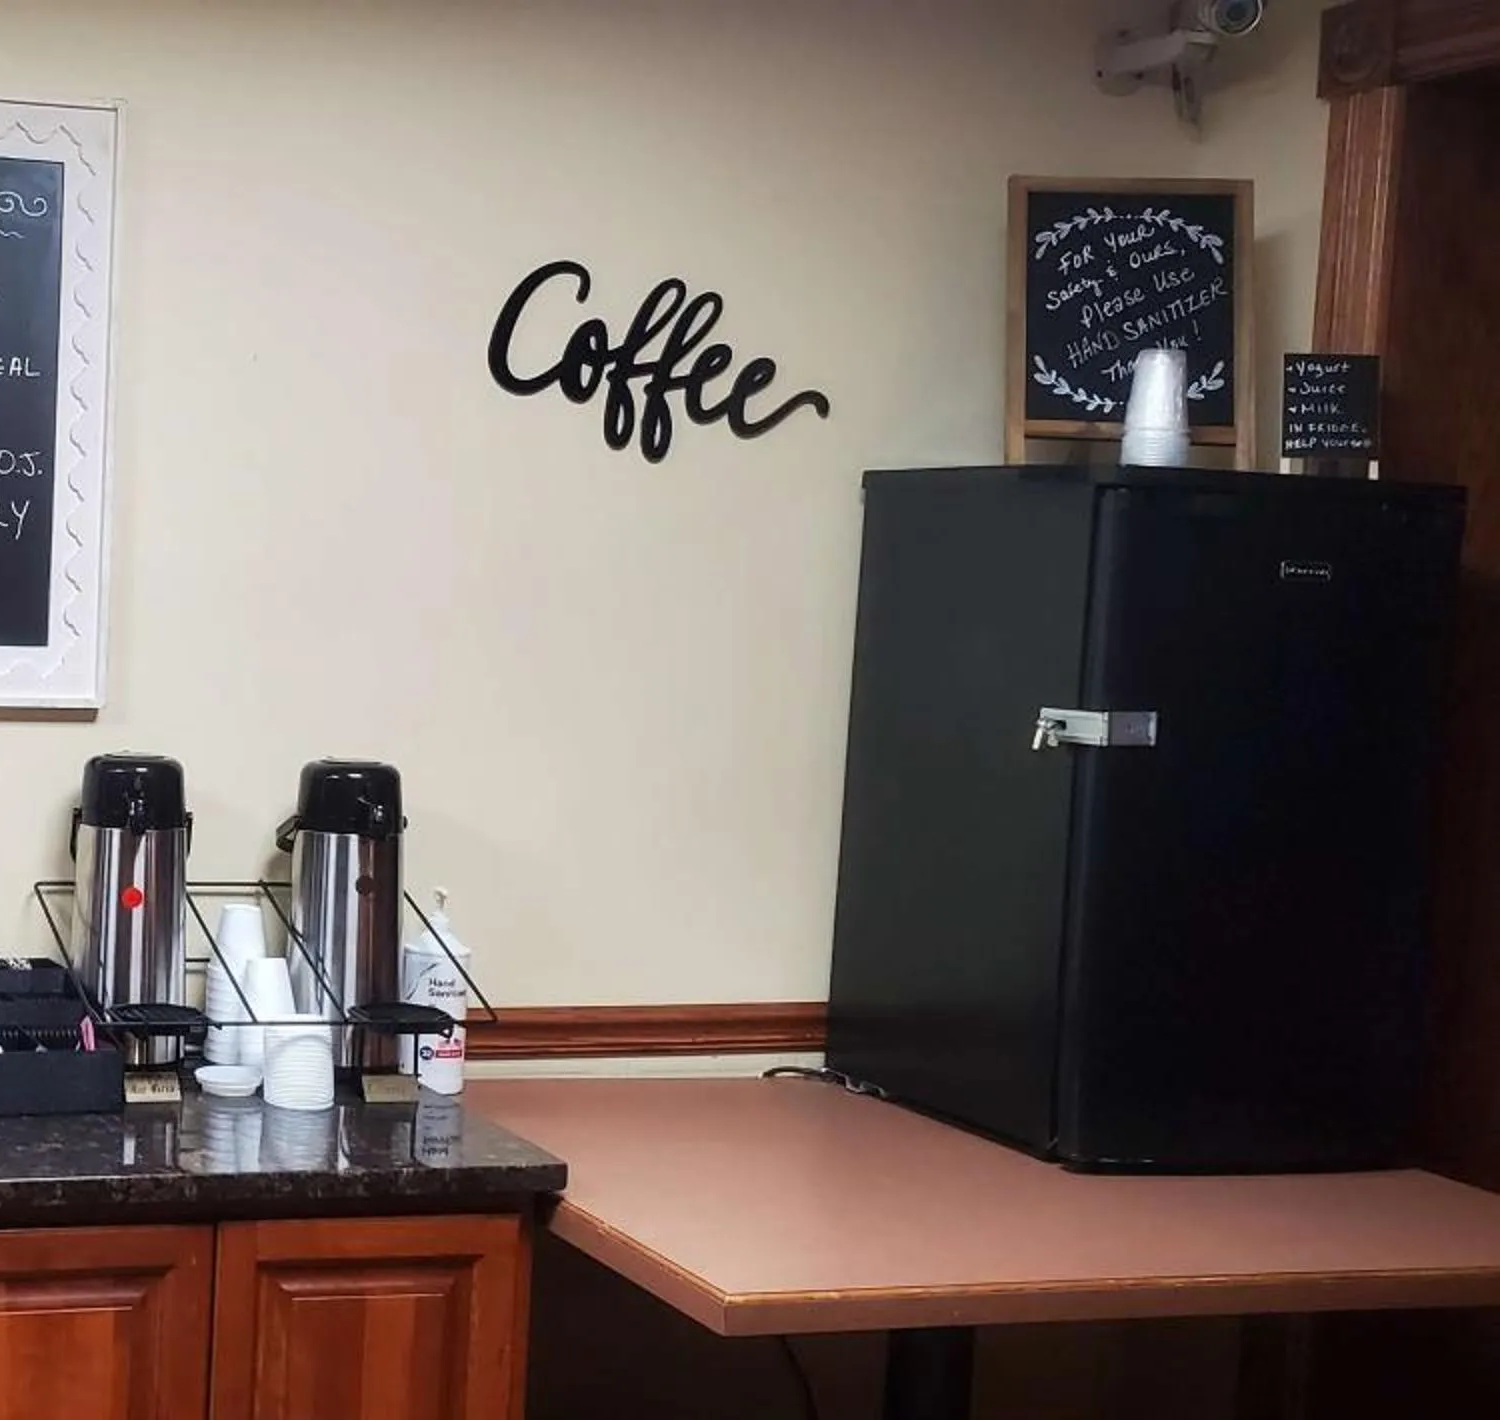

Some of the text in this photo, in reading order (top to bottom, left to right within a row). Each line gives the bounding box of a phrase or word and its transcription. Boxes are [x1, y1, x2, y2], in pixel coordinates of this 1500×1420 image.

[1066, 276, 1228, 368] HAND SANITIZER
[488, 260, 830, 463] Coffee
[1284, 437, 1317, 450] HELP
[429, 978, 455, 987] Hand
